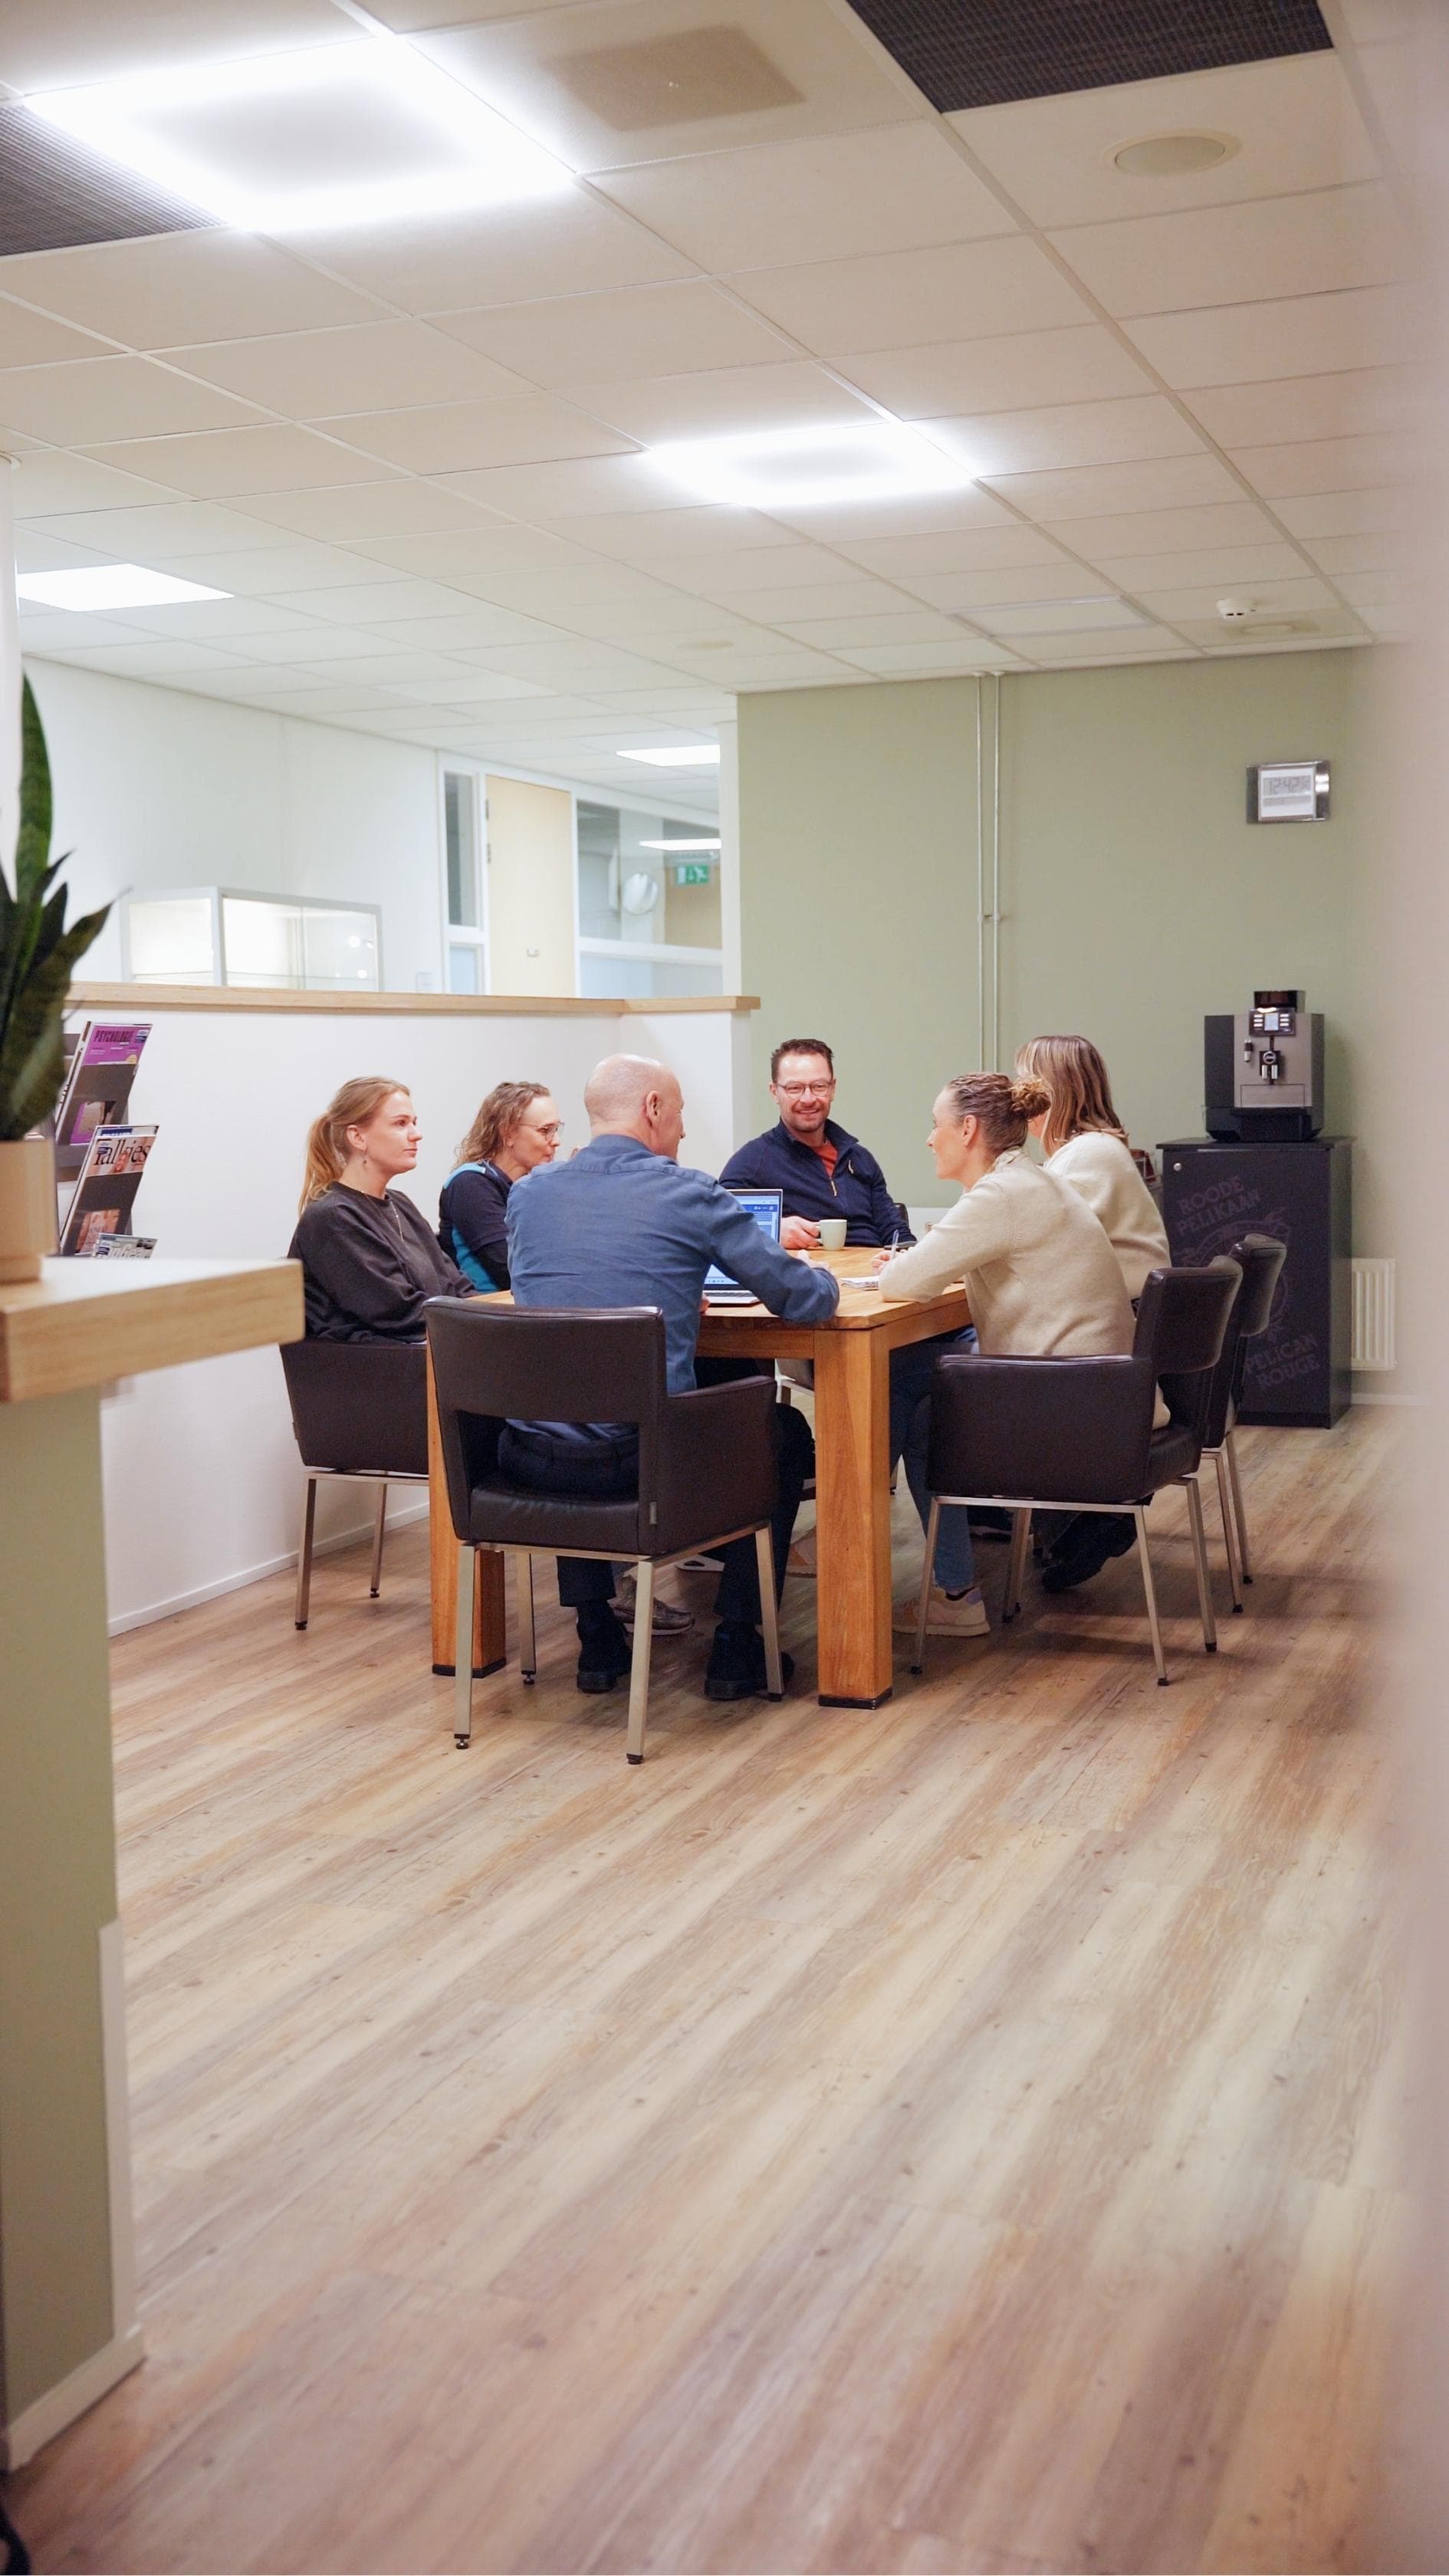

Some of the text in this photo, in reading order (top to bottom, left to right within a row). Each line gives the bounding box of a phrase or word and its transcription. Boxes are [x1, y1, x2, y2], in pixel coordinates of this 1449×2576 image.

[1175, 1188, 1260, 1237] PELIKAAN
[1177, 1175, 1244, 1214] ROODE
[1259, 1356, 1320, 1388] ROUGE
